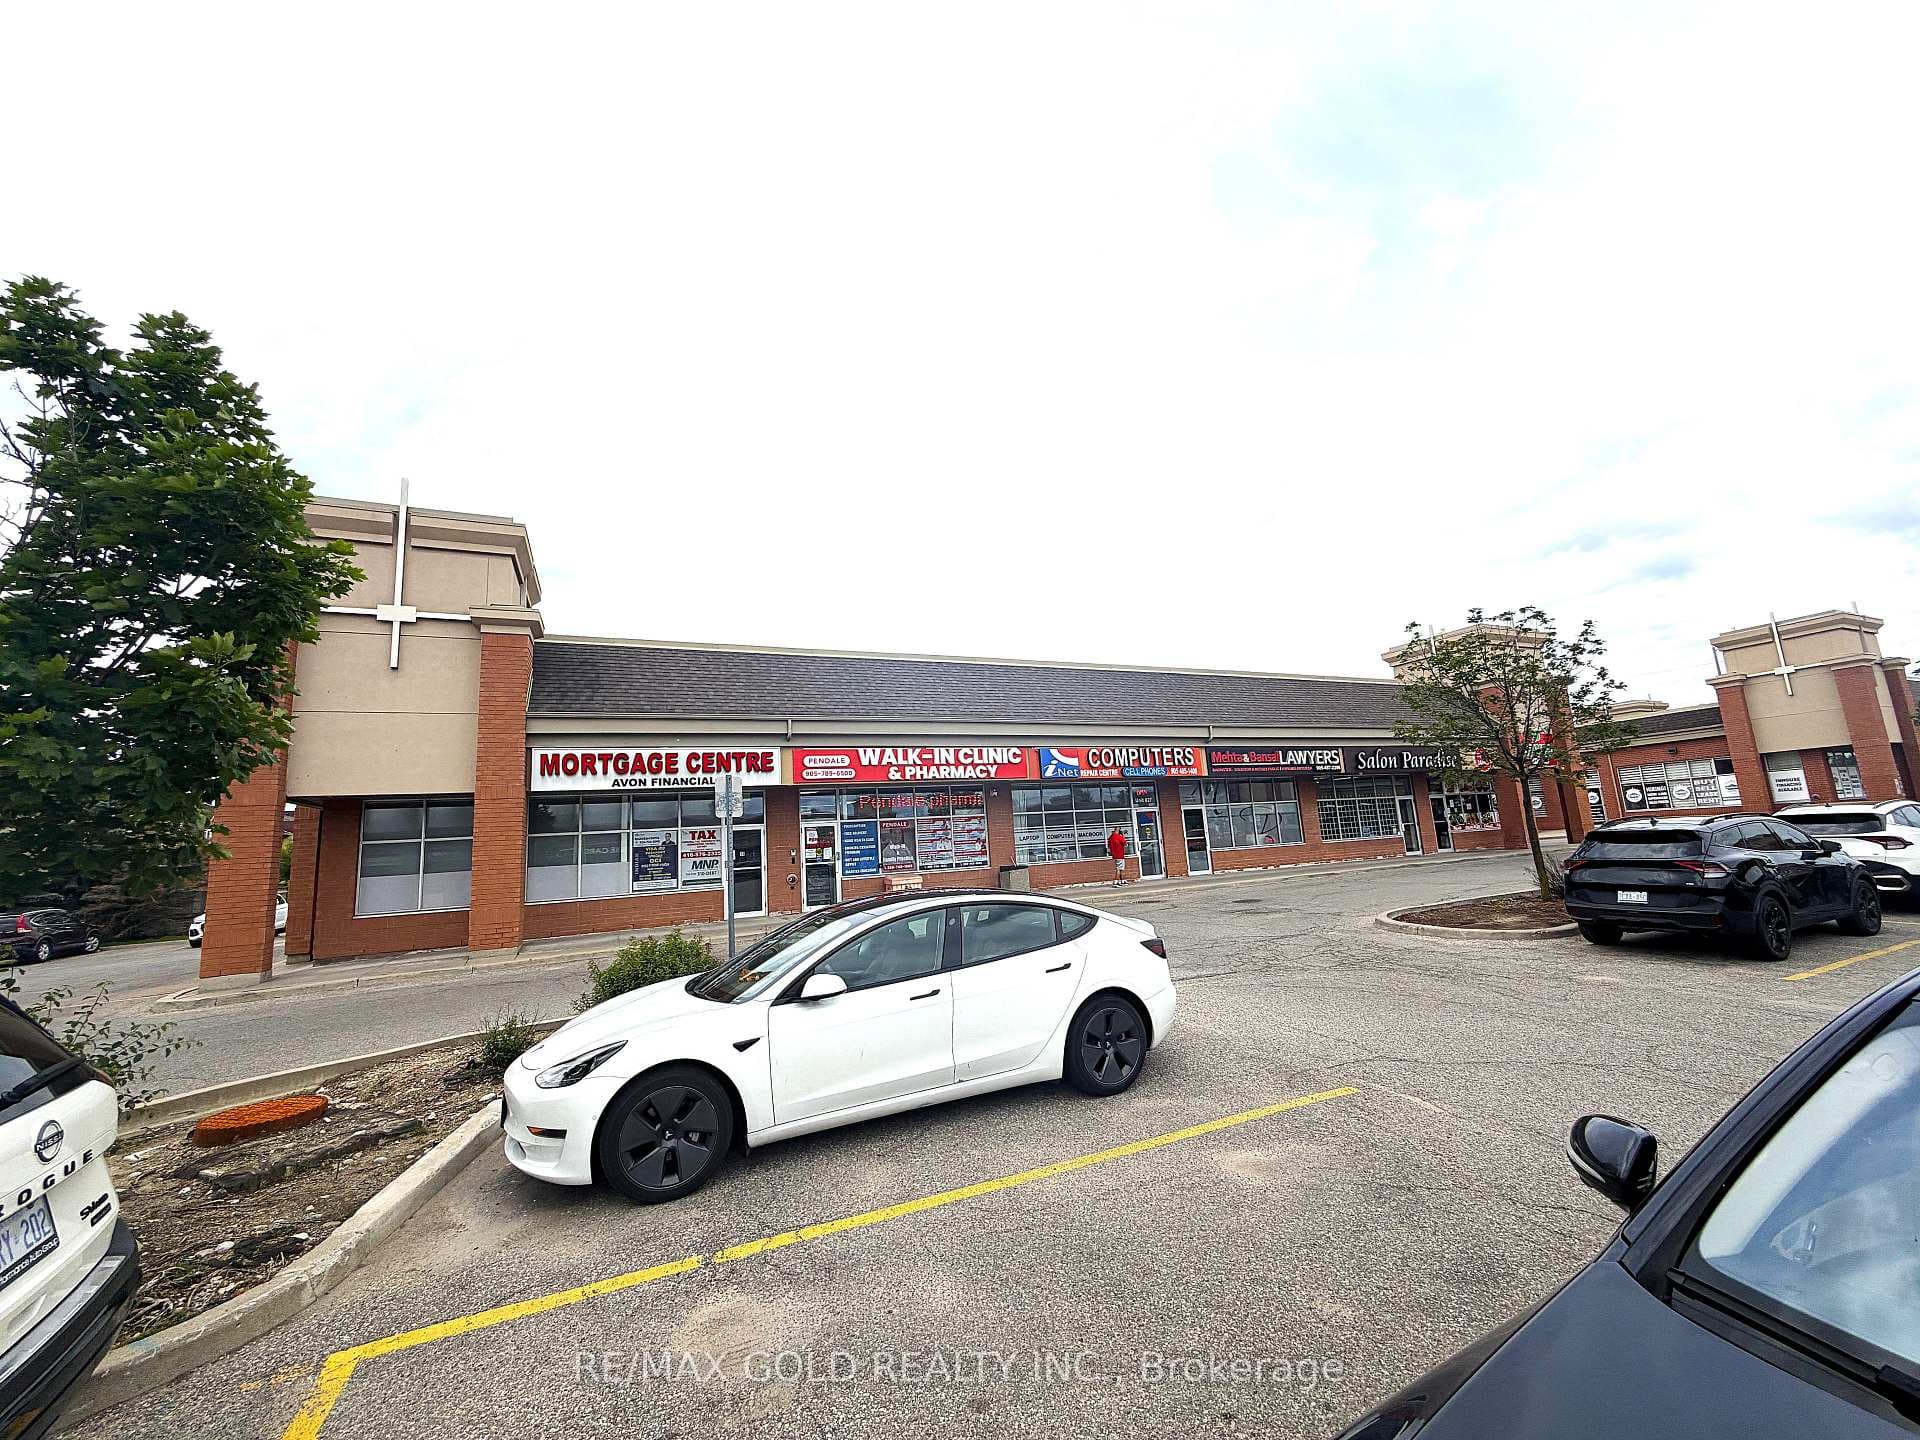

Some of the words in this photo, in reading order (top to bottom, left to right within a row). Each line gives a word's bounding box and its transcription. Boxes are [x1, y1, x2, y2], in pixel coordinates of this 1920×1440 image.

[808, 757, 847, 765] PENDALE
[858, 747, 956, 766] WALK-IN
[957, 747, 1023, 764] CLINIC
[1087, 747, 1196, 768] COMPUTERS
[1212, 751, 1244, 763] Mehta
[1242, 753, 1250, 763] &
[1249, 751, 1279, 762] Bansal
[1279, 750, 1340, 765] LAWYERS
[1357, 748, 1397, 769] Salon
[539, 752, 680, 777] MORTGAGE
[685, 751, 775, 774] CENTRE
[887, 766, 903, 780] &
[904, 765, 998, 780] PHARMACY
[1057, 768, 1079, 777] Net
[1080, 769, 1098, 777] REPAIR
[1098, 768, 1119, 776] CENTRE
[1124, 767, 1141, 776] CELL
[1141, 767, 1166, 775] PHONES
[611, 778, 648, 788] AVON
[651, 776, 716, 787] FINANCIAL
[689, 830, 717, 840] TAX
[691, 860, 719, 869] MNP
[21, 1207, 51, 1250] 202
